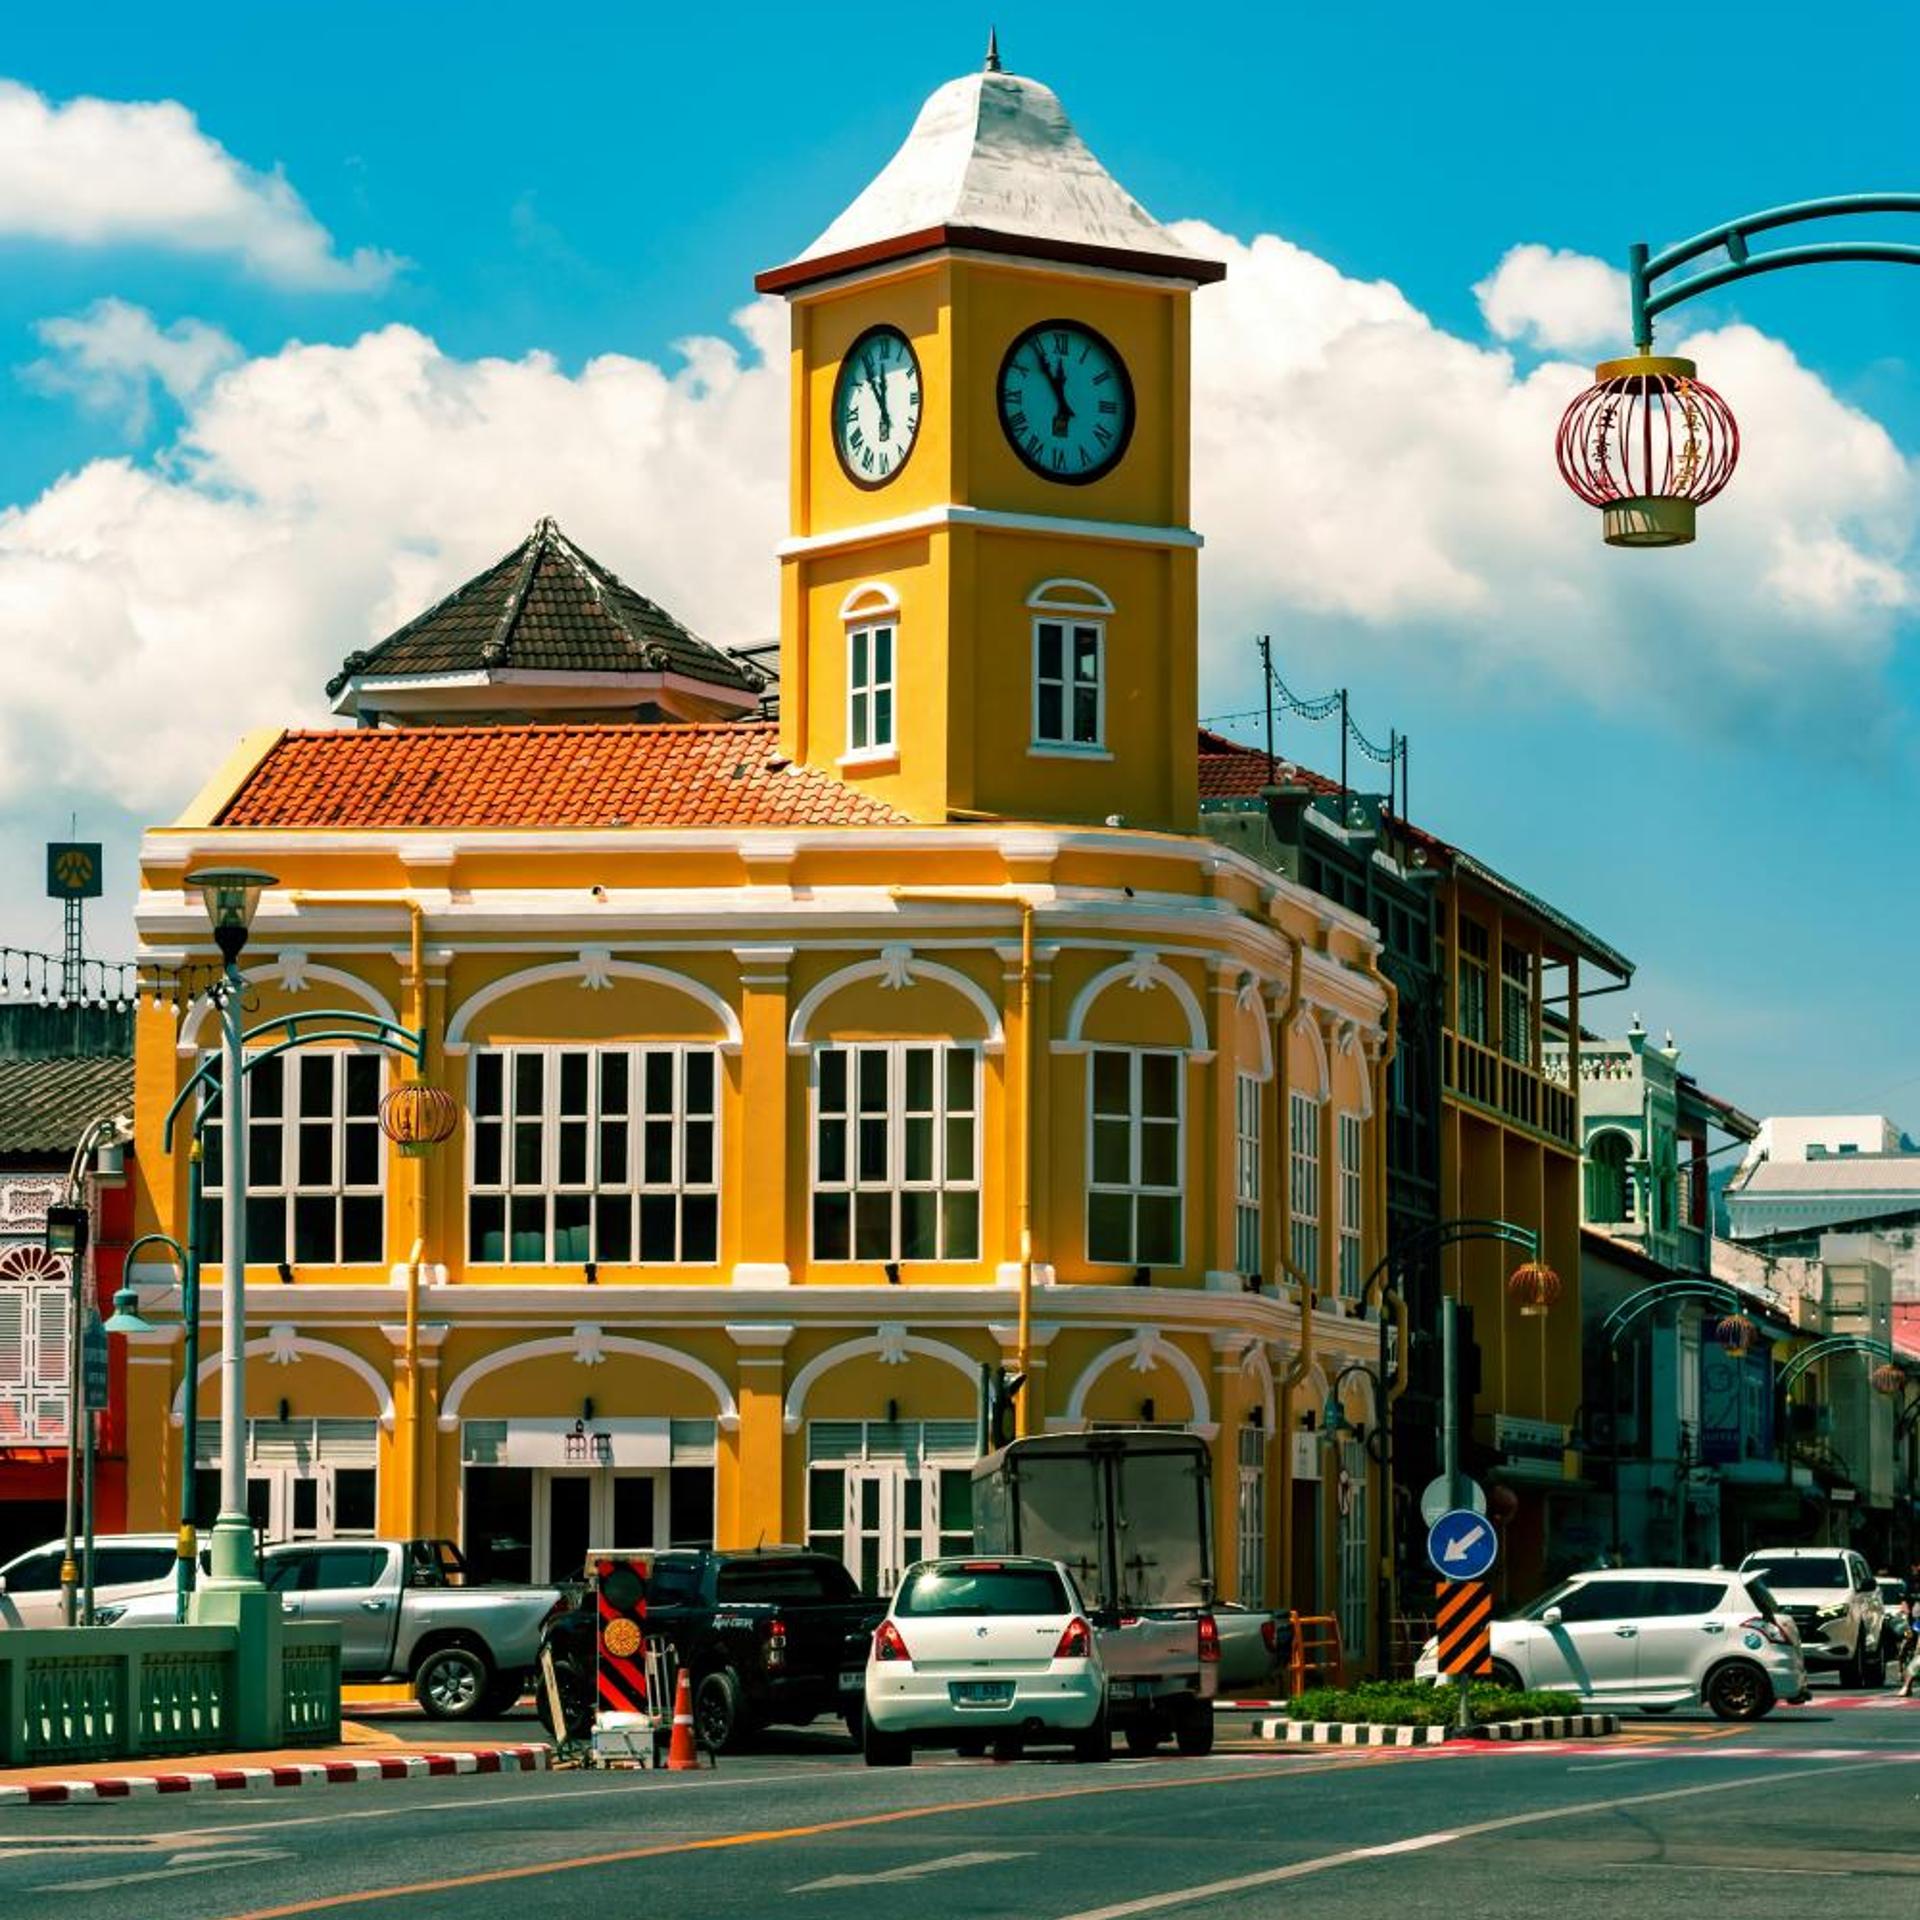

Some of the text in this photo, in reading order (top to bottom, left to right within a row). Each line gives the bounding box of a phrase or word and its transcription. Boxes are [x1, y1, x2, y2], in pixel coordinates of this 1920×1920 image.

[1053, 334, 1069, 356] XII
[1079, 345, 1092, 365] I
[1093, 369, 1112, 386] II
[1098, 400, 1118, 415] III
[1052, 447, 1067, 472] VI
